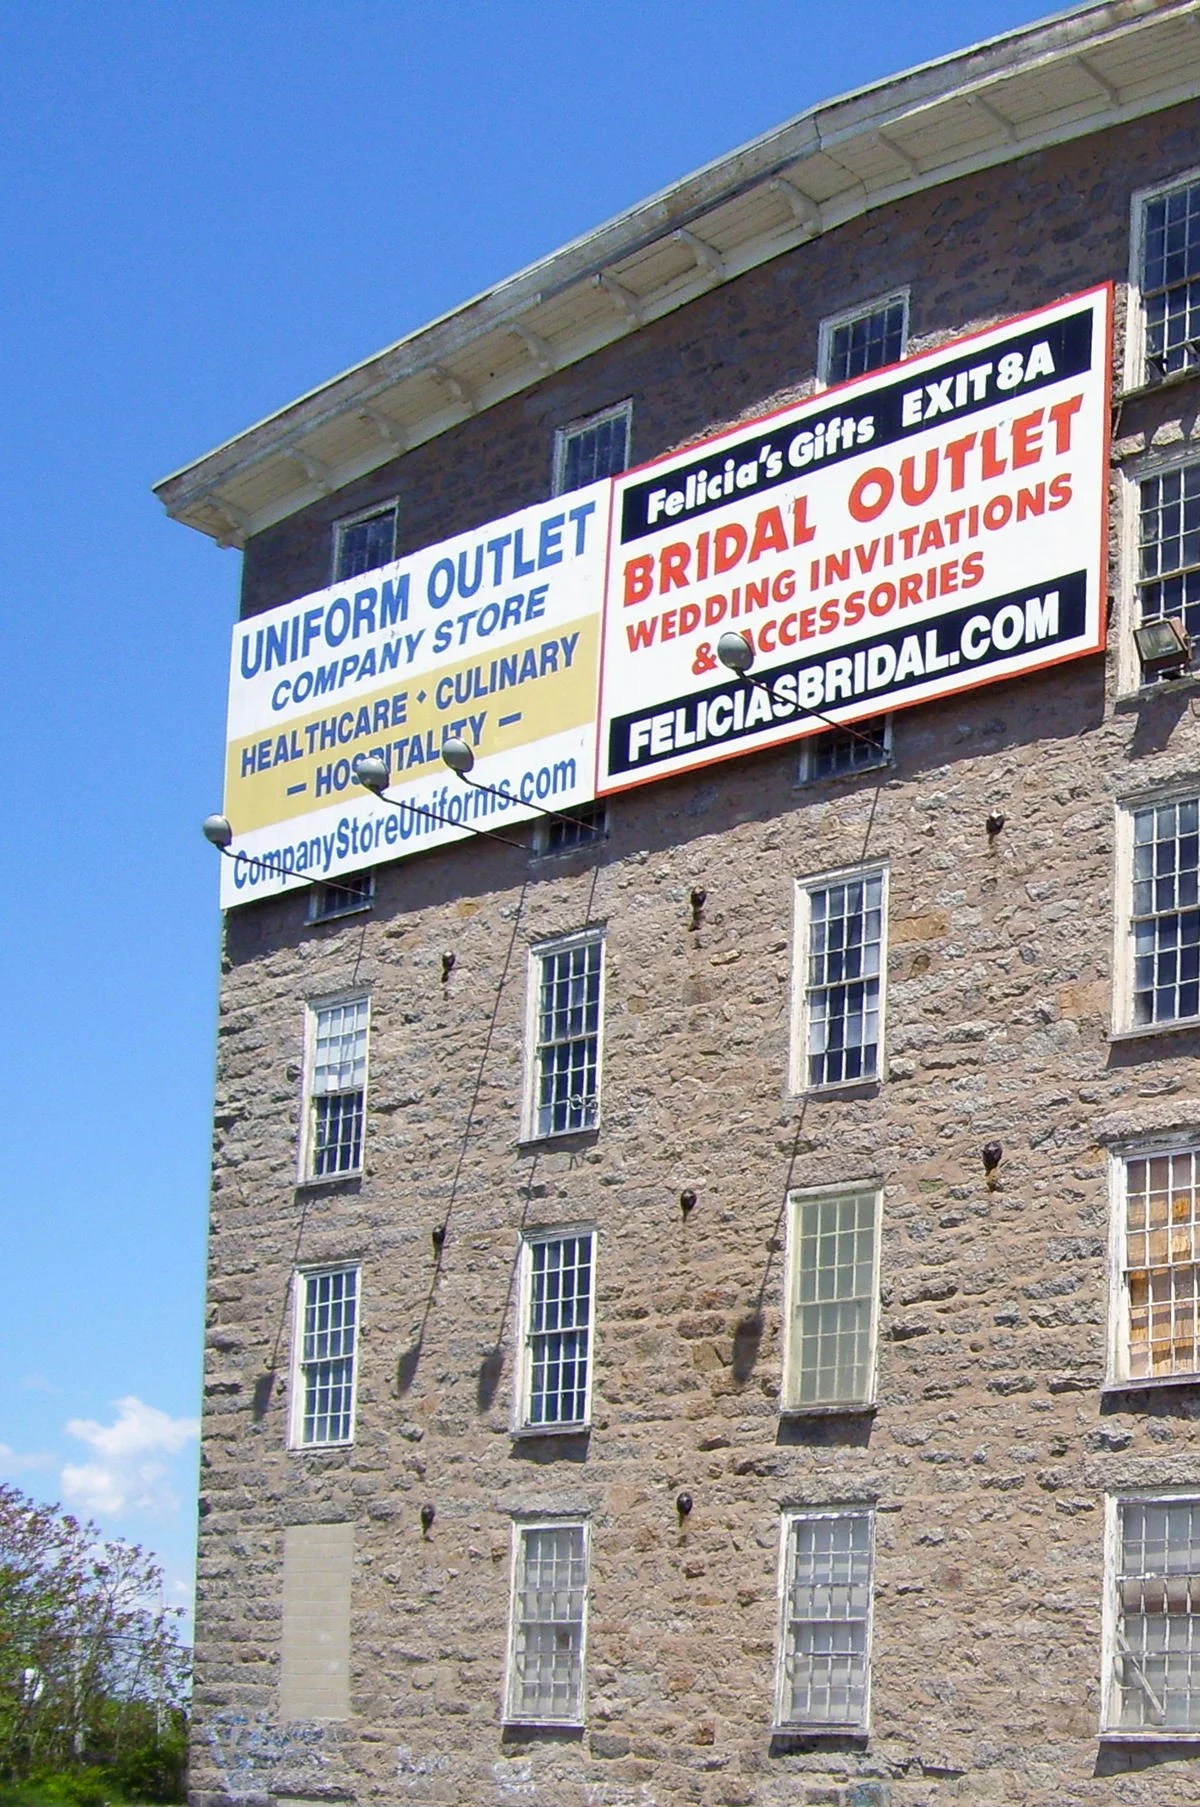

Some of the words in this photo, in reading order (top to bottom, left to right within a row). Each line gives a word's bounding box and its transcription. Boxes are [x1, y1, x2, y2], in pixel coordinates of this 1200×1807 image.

[623, 496, 816, 607] BRIDAL
[848, 394, 1084, 523] OUTLET
[647, 444, 782, 525] Felicia's
[788, 413, 875, 467] Gifts
[902, 369, 992, 427] EXIT
[997, 341, 1055, 391] 8A
[240, 575, 410, 680] UNIFORM
[427, 501, 595, 609] OUTLET
[271, 628, 426, 711] COMPANY
[432, 584, 549, 653] STORE
[626, 569, 795, 652] WEDDING
[810, 473, 1073, 591] INVITATIONS
[241, 691, 408, 777] HEALTHCARE
[436, 632, 580, 710] CULINARY
[628, 591, 1059, 762] FELICIASBRIDAL.COM
[692, 642, 717, 676] &
[233, 757, 576, 889] CompanyStoreUniforms.com
